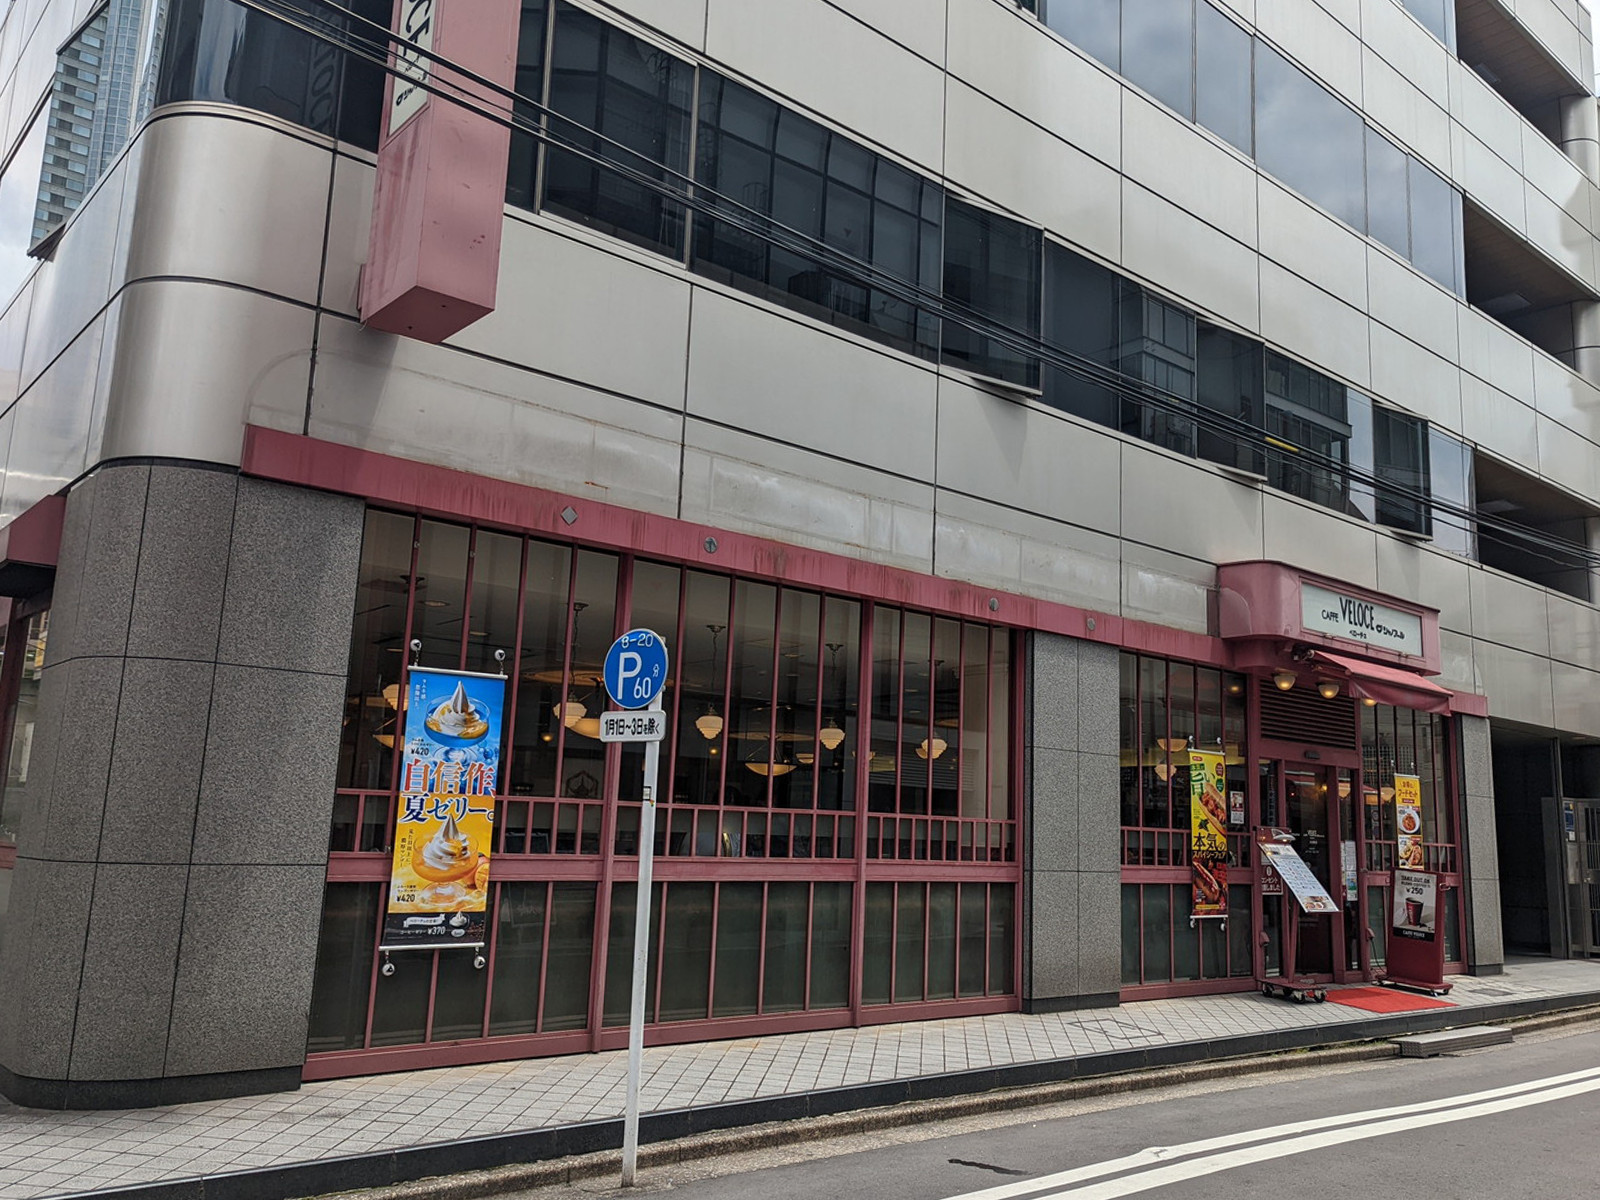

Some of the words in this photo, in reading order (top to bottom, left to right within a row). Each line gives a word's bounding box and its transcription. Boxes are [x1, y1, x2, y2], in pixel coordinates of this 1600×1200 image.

[1339, 596, 1375, 631] VELOCE
[621, 633, 654, 648] 8-20
[617, 651, 642, 700] P
[652, 663, 660, 677] 分
[633, 677, 652, 699] 60
[410, 747, 430, 756] ¥420
[1193, 832, 1227, 851] 本気の
[1192, 850, 1226, 860] スパイシーフェア
[396, 893, 416, 903] ¥420
[1406, 887, 1423, 895] ¥250
[427, 926, 446, 935] ¥370
